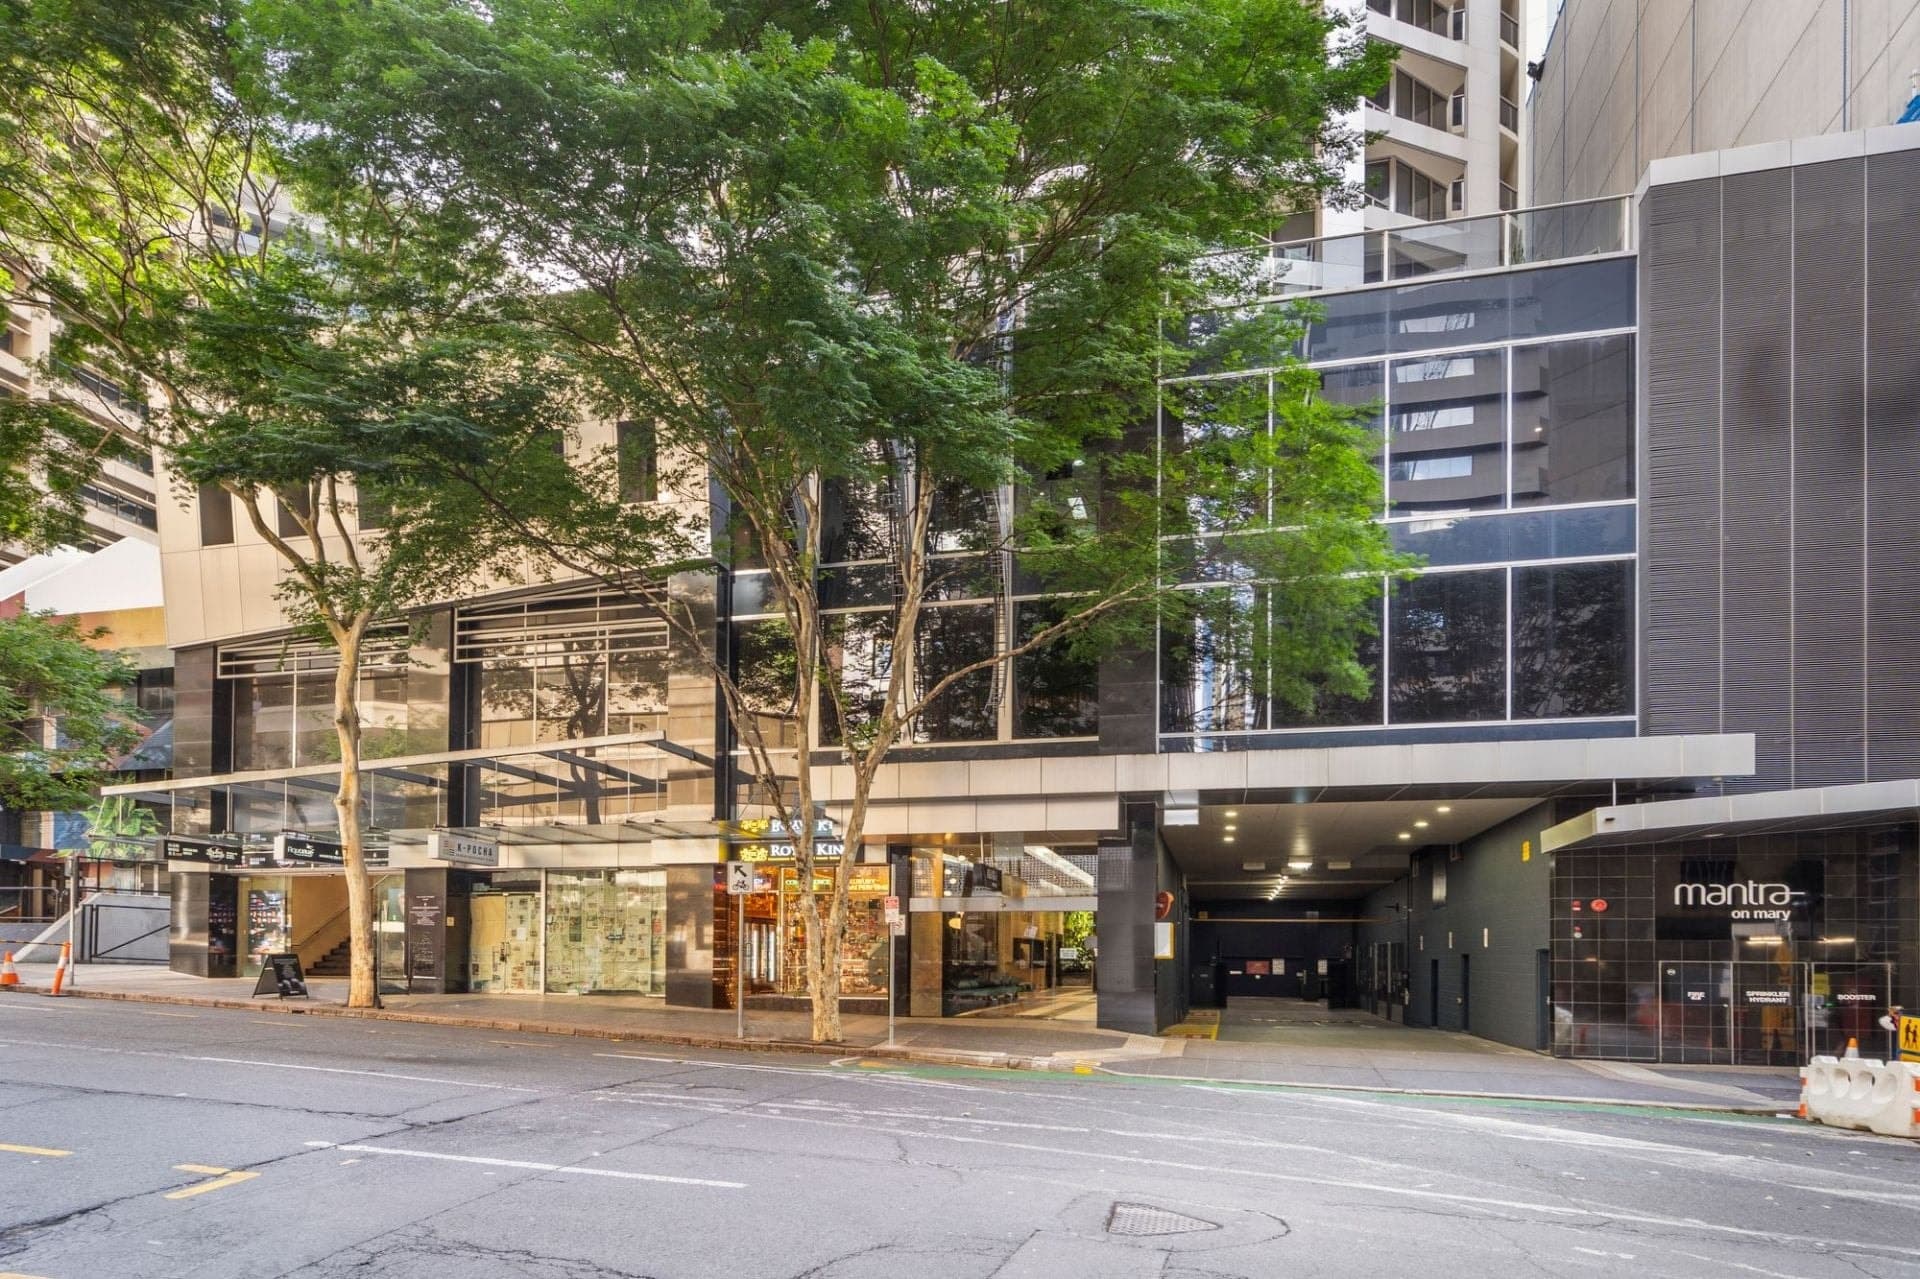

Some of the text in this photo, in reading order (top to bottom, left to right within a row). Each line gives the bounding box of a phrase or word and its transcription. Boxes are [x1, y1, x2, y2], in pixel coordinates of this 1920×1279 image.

[457, 843, 492, 857] K-POCHA
[816, 843, 845, 856] KIN
[1674, 880, 1806, 906] mantra
[1731, 909, 1792, 921] on mary
[1746, 990, 1791, 998] SPRINKLER
[1837, 993, 1877, 1001] BOOSTER
